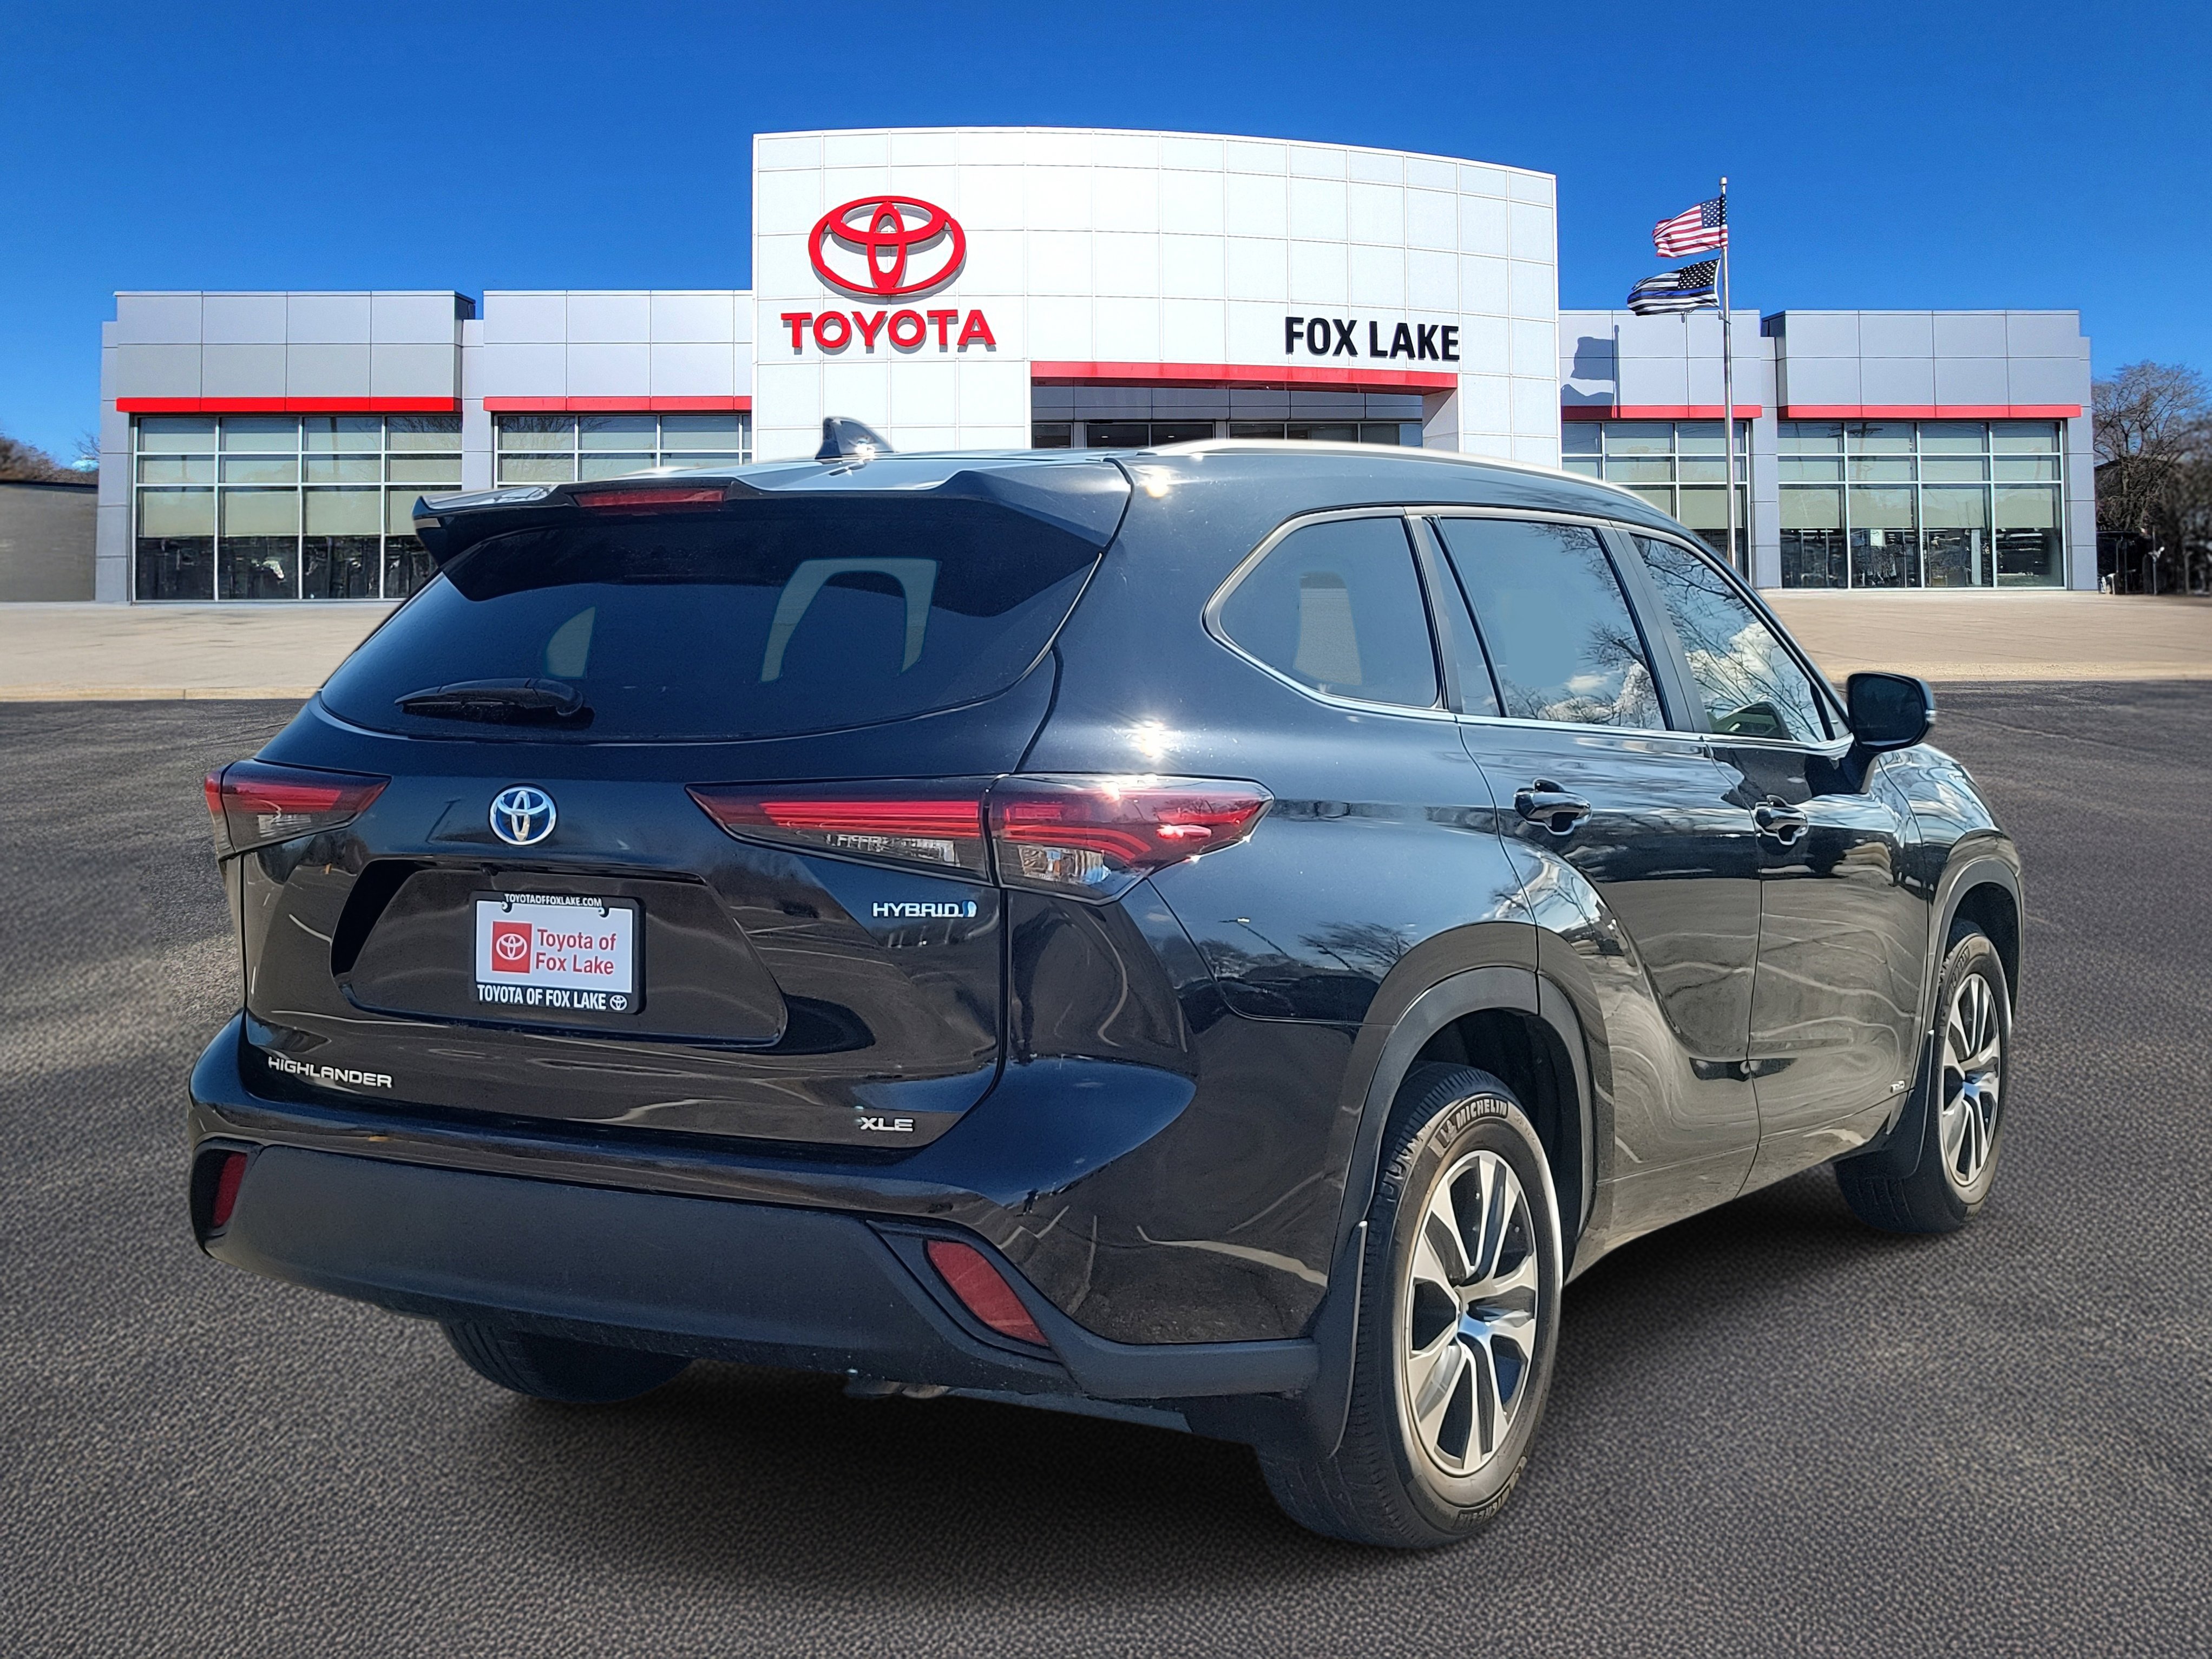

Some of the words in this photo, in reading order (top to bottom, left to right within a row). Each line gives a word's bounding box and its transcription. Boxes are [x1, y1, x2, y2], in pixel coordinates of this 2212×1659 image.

[781, 310, 996, 351] TOYOTA
[1285, 317, 1358, 357] FOX
[1369, 320, 1460, 362] LAKE
[504, 893, 602, 907] TOYOTAOFFOXLAKE.COM
[872, 902, 961, 917] HYBRID
[537, 928, 593, 952] Toyota
[599, 933, 617, 950] of
[535, 952, 567, 972] Fox
[573, 954, 614, 975] Lake
[477, 984, 523, 1004] TOYOTA
[526, 987, 543, 1005] OF
[546, 989, 570, 1007] FOX
[574, 991, 607, 1010] LAKE
[268, 1056, 392, 1088] HIGHLANDER
[860, 1117, 914, 1132] XLE
[1455, 1098, 1508, 1129] MICHELIN
